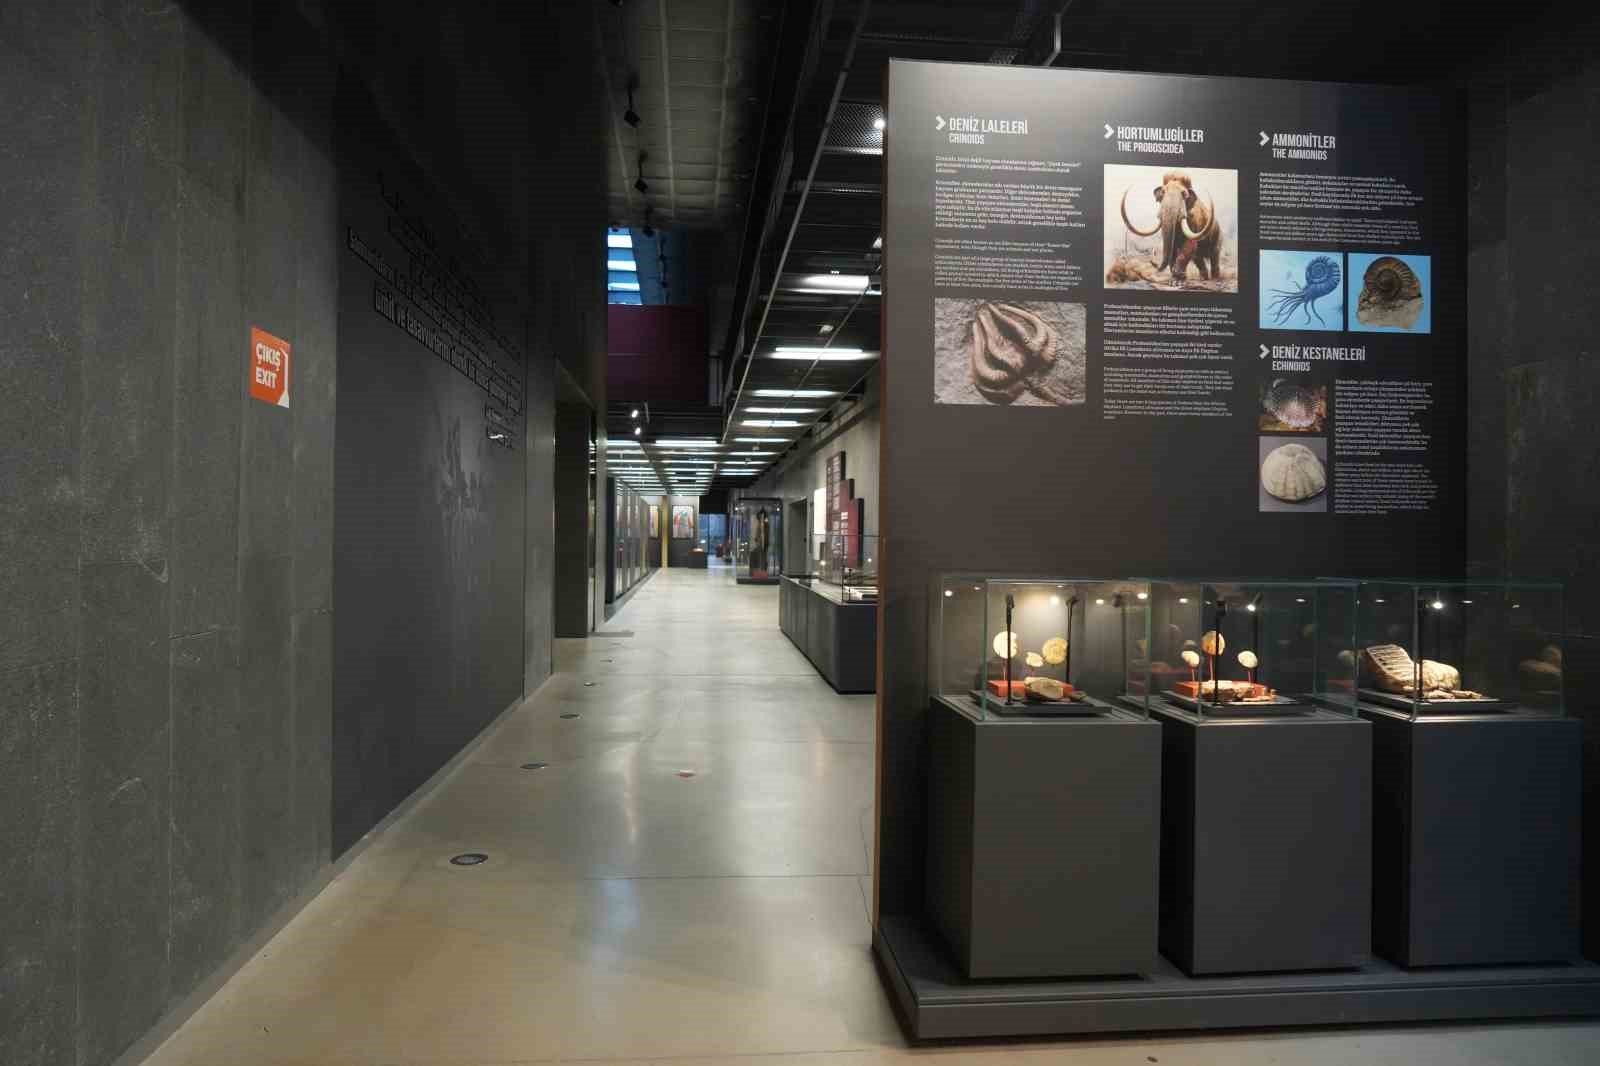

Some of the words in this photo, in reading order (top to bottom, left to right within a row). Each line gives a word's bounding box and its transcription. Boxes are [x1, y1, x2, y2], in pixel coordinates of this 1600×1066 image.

[949, 115, 979, 132] DENİZ
[981, 119, 1028, 134] LALELERİ
[1117, 126, 1204, 143] HORTUMLUGİLLER
[1272, 132, 1336, 149] AMMONİTLER
[1117, 141, 1132, 152] THE
[1133, 142, 1184, 153] PROBOSCIDEA
[1272, 148, 1287, 159] THE
[256, 343, 281, 372] ÇIKIŞ
[1272, 344, 1301, 360] DENİZ
[1302, 345, 1366, 361] KESTANELERİ
[1272, 360, 1311, 372] ECHINOIDS
[256, 366, 278, 389] EXIT
